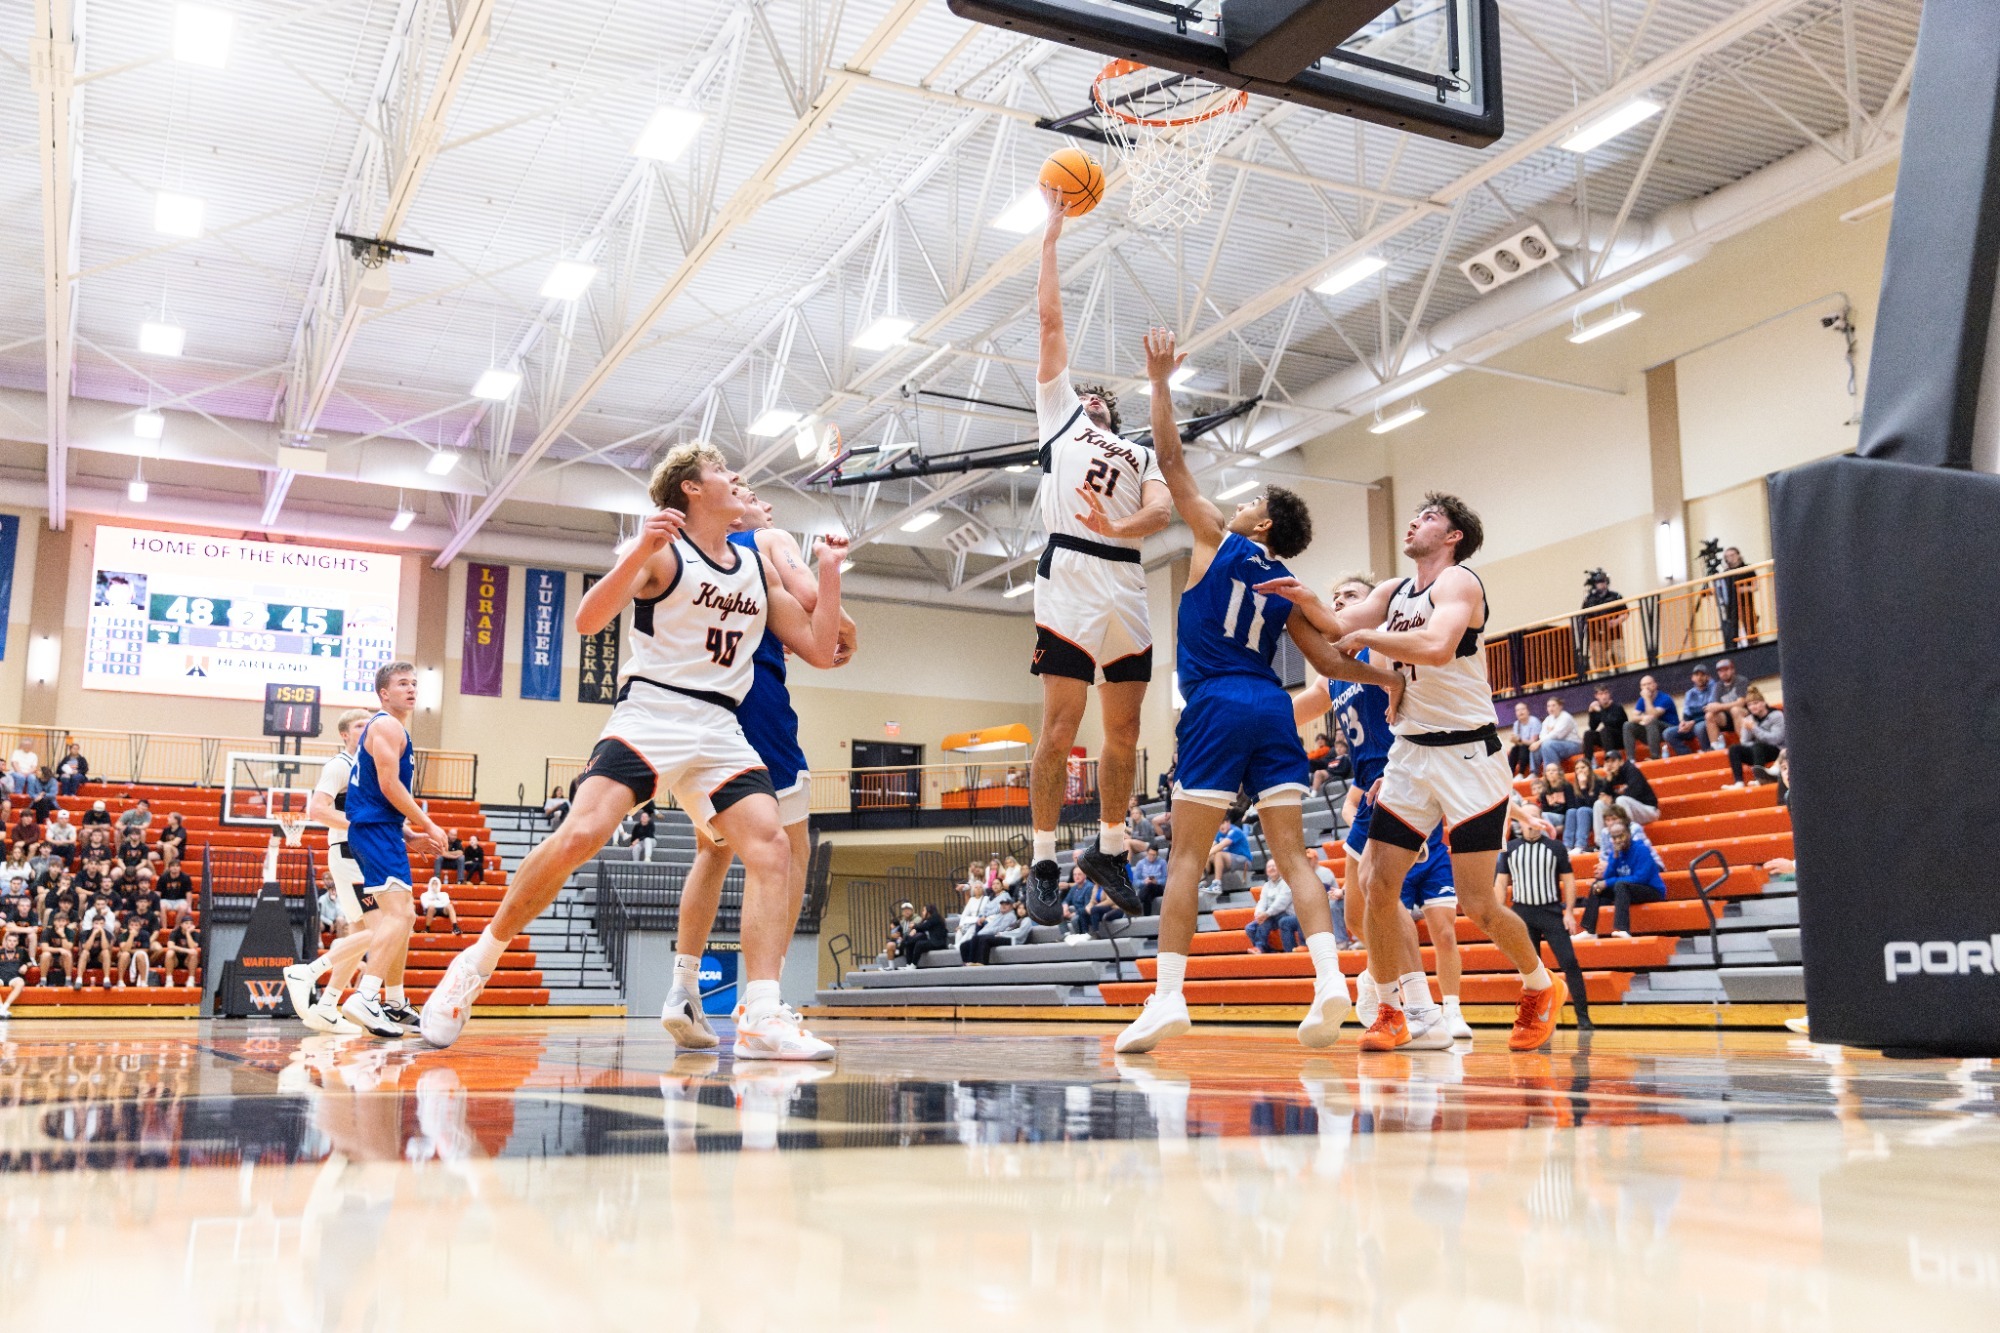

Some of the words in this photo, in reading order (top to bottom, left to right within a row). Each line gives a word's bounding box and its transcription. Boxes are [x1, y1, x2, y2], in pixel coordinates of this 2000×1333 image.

[1083, 458, 1120, 497] 21
[132, 537, 196, 555] HOME
[204, 544, 230, 558] OF
[240, 548, 274, 562] THE
[282, 552, 369, 572] KNIGHTS
[166, 596, 214, 626] 48
[477, 569, 495, 645] LORAS
[693, 582, 760, 621] Knights
[1223, 578, 1268, 654] 11
[281, 606, 328, 637] 45
[534, 575, 552, 665] LUTHER
[217, 631, 276, 651] 15:03
[706, 627, 743, 668] 40
[218, 658, 308, 672] HEARTLAND
[600, 620, 616, 698] SLEYAN
[277, 686, 315, 702] 15:03
[286, 705, 310, 731] 11
[242, 956, 294, 968] WARTBURG
